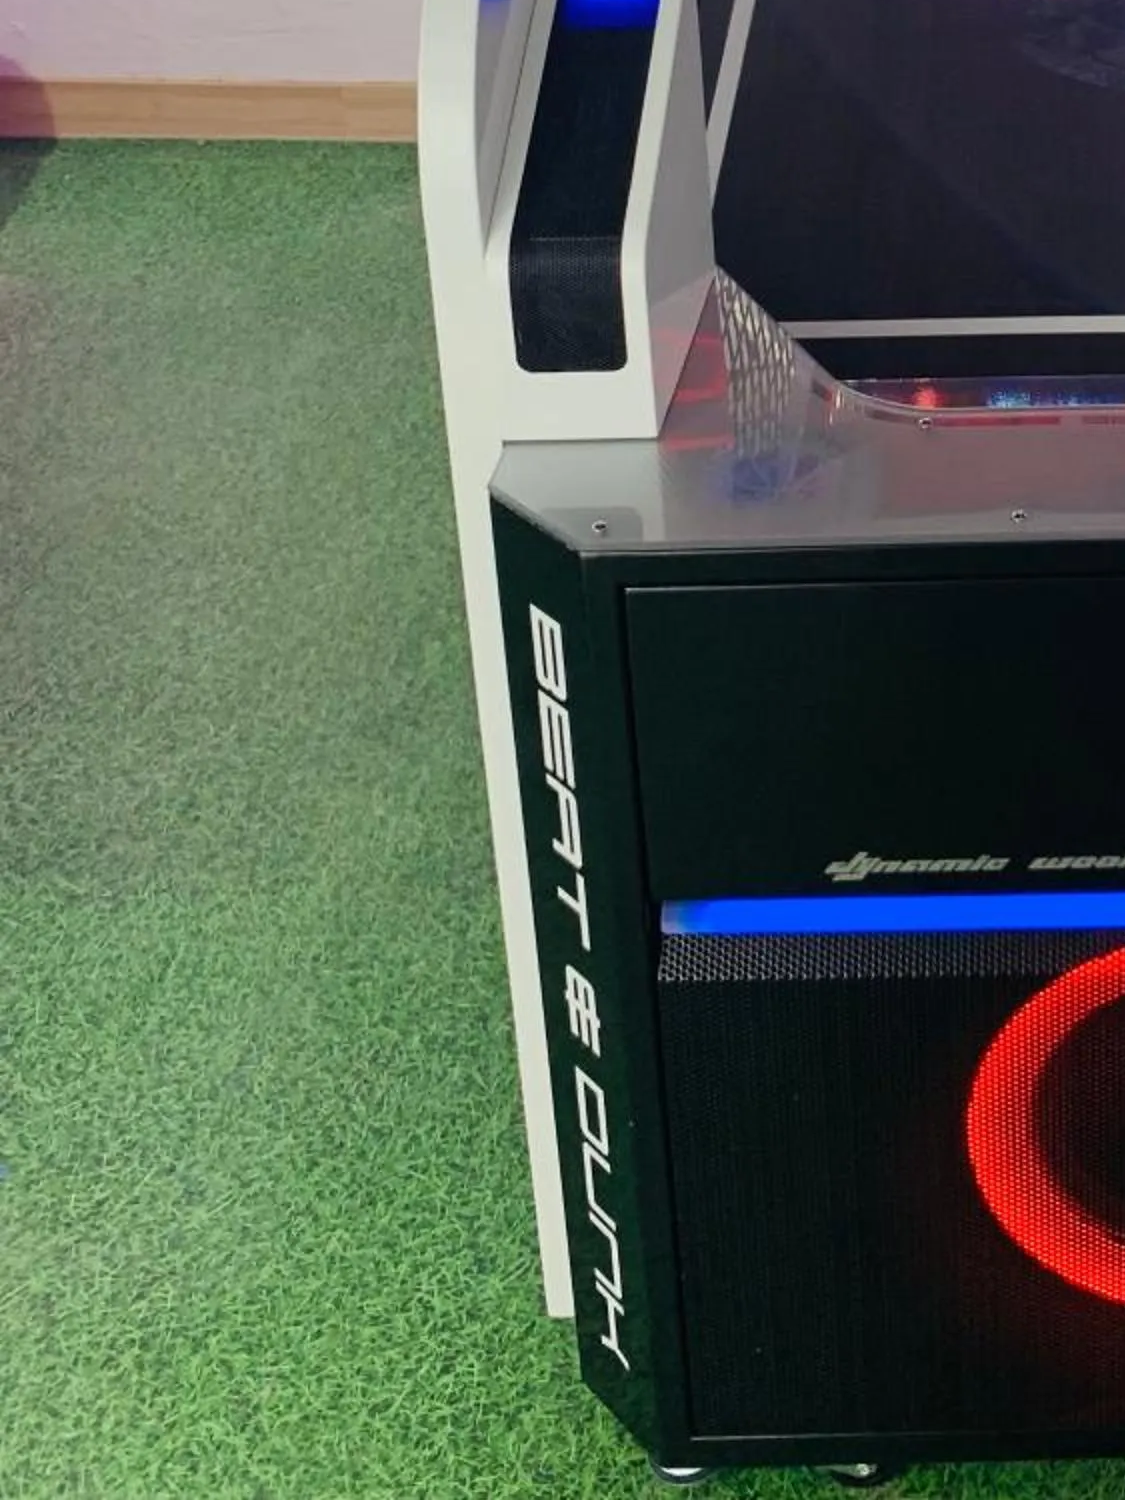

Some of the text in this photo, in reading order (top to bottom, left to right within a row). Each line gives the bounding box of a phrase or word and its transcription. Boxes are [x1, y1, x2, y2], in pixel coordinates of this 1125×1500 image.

[529, 603, 591, 952] BEAT
[574, 1065, 630, 1371] DUNK
[824, 851, 1010, 881] dynamic
